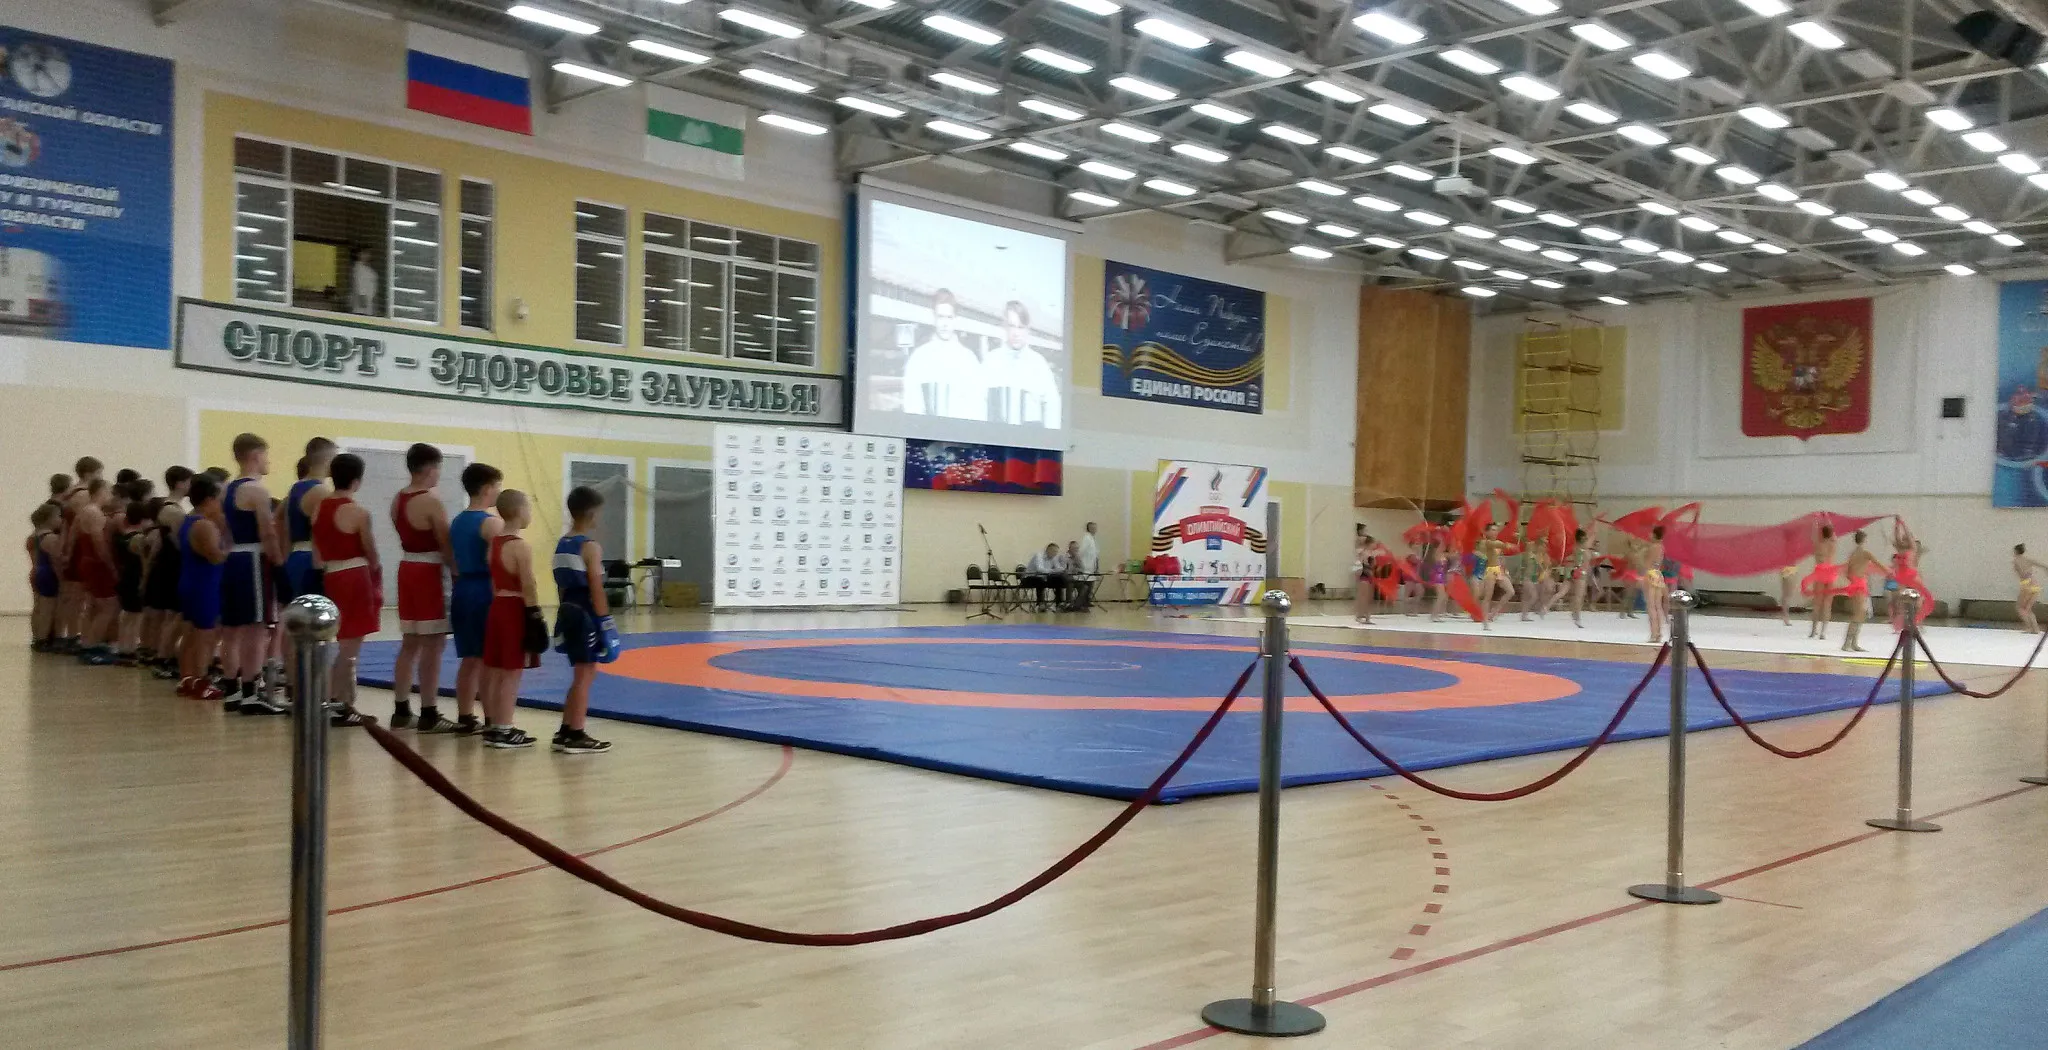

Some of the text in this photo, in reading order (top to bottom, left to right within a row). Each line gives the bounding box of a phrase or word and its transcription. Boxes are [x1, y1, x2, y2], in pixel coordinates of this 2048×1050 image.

[81, 110, 163, 135] ОБЛАСТИ
[14, 193, 32, 207] И
[36, 196, 125, 218] ТУРИЗМУ
[223, 320, 386, 375] СПОРТ
[430, 347, 631, 401] ЗДОРОВЬЕ
[640, 370, 821, 416] ЗАУРАЛЬЯ!
[1131, 377, 1246, 406] ЕДИНАЯ РОССИЯ
